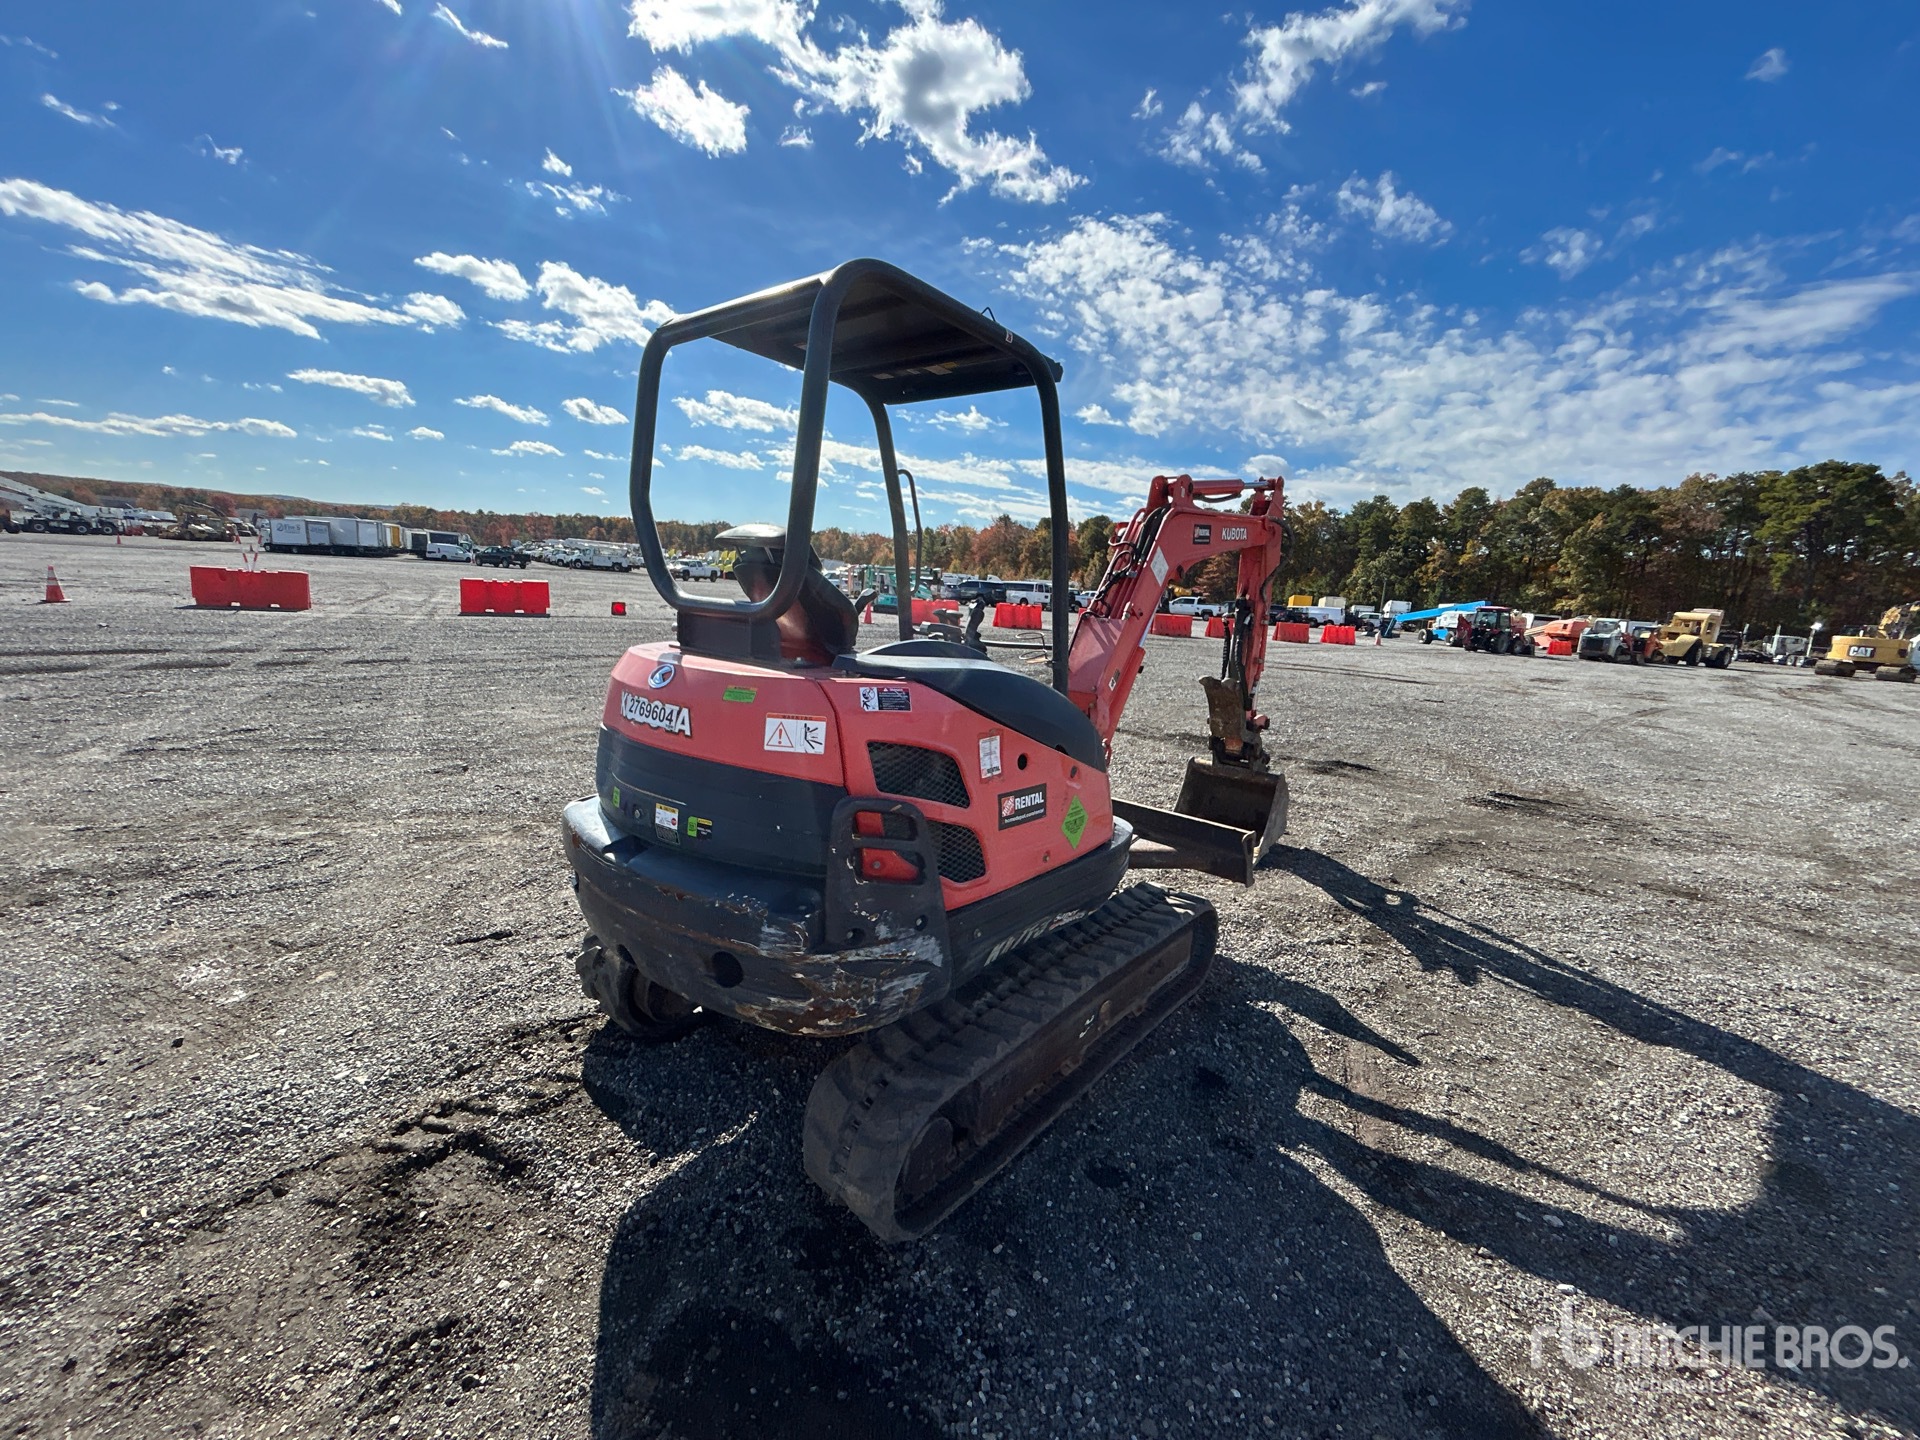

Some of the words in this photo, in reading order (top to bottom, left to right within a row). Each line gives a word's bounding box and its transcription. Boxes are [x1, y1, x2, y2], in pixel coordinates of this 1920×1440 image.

[1221, 527, 1248, 541] KUBOTA
[1849, 646, 1874, 658] CAT
[629, 698, 675, 725] 2769604
[1015, 792, 1044, 810] RENTAL
